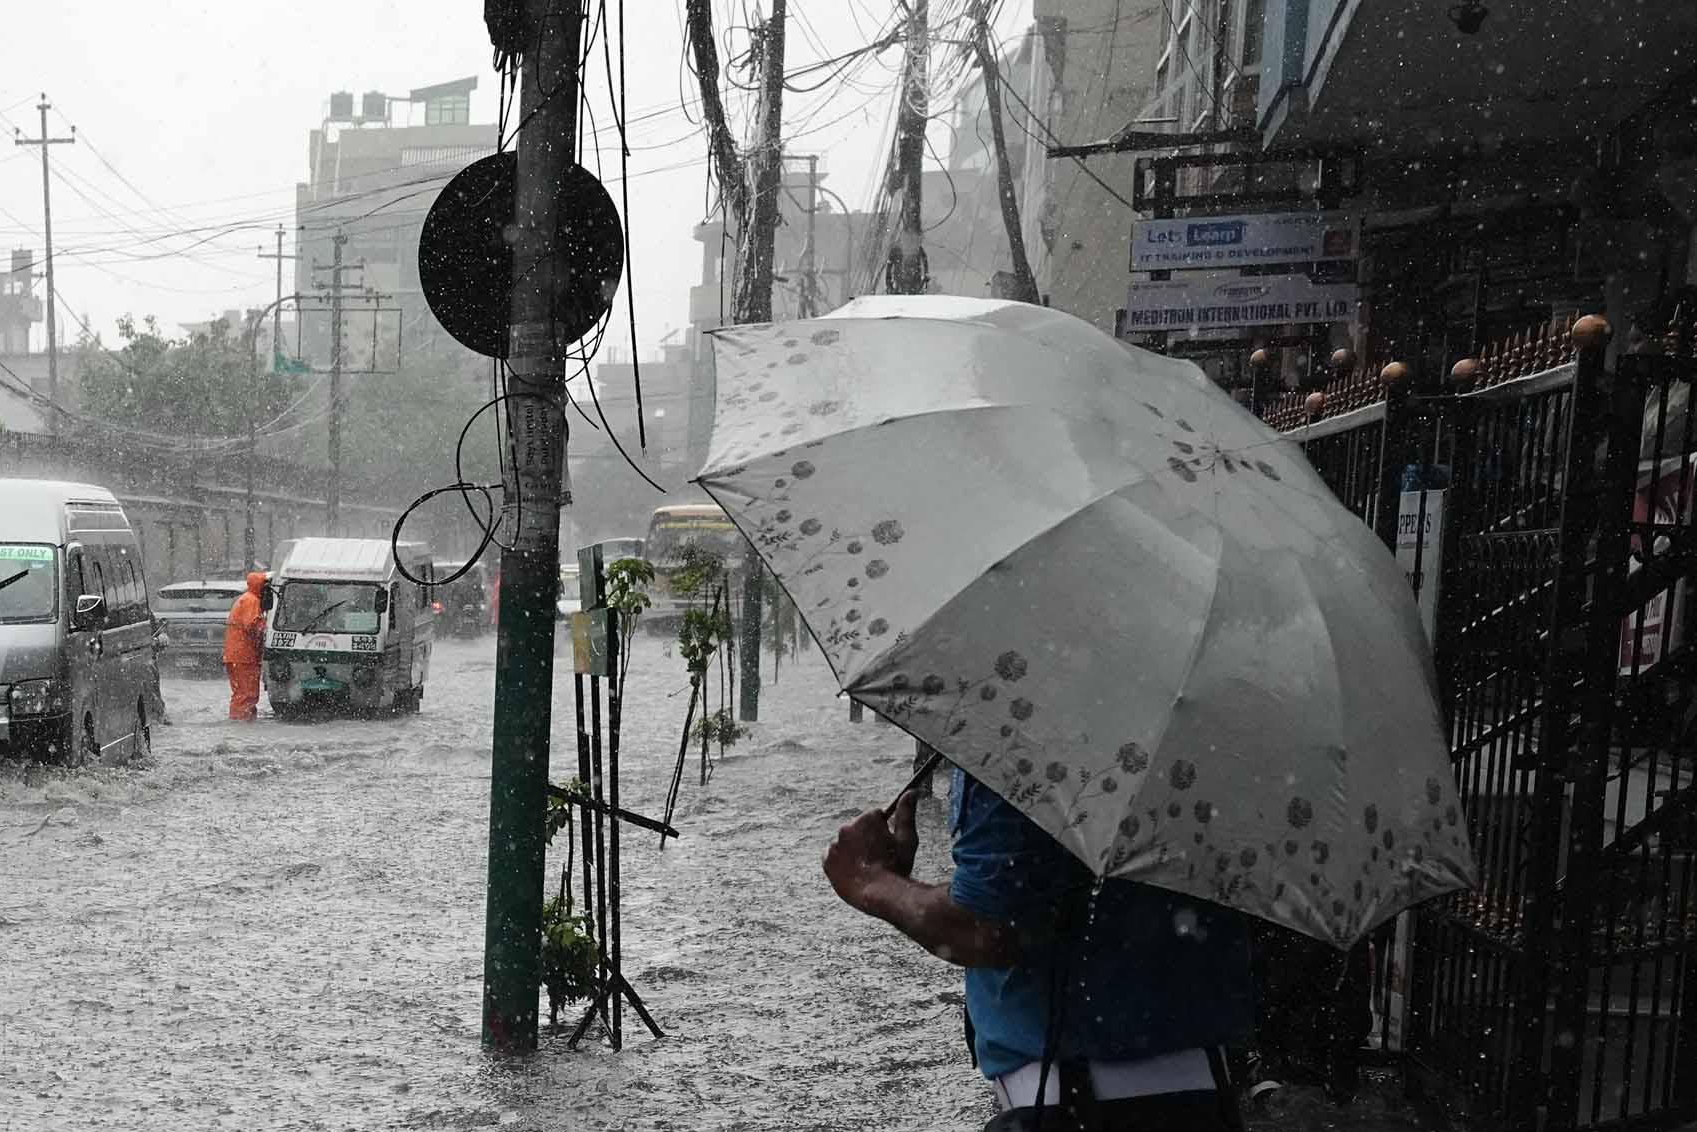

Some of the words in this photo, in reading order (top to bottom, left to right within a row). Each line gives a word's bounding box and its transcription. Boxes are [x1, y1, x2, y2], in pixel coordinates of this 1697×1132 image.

[1227, 246, 1313, 259] DEVELOPMENT
[1131, 308, 1195, 325] MEDITRON
[1197, 304, 1291, 322] INTERNATIONAL
[1294, 302, 1322, 319] PVT.
[17, 548, 48, 558] ONLY
